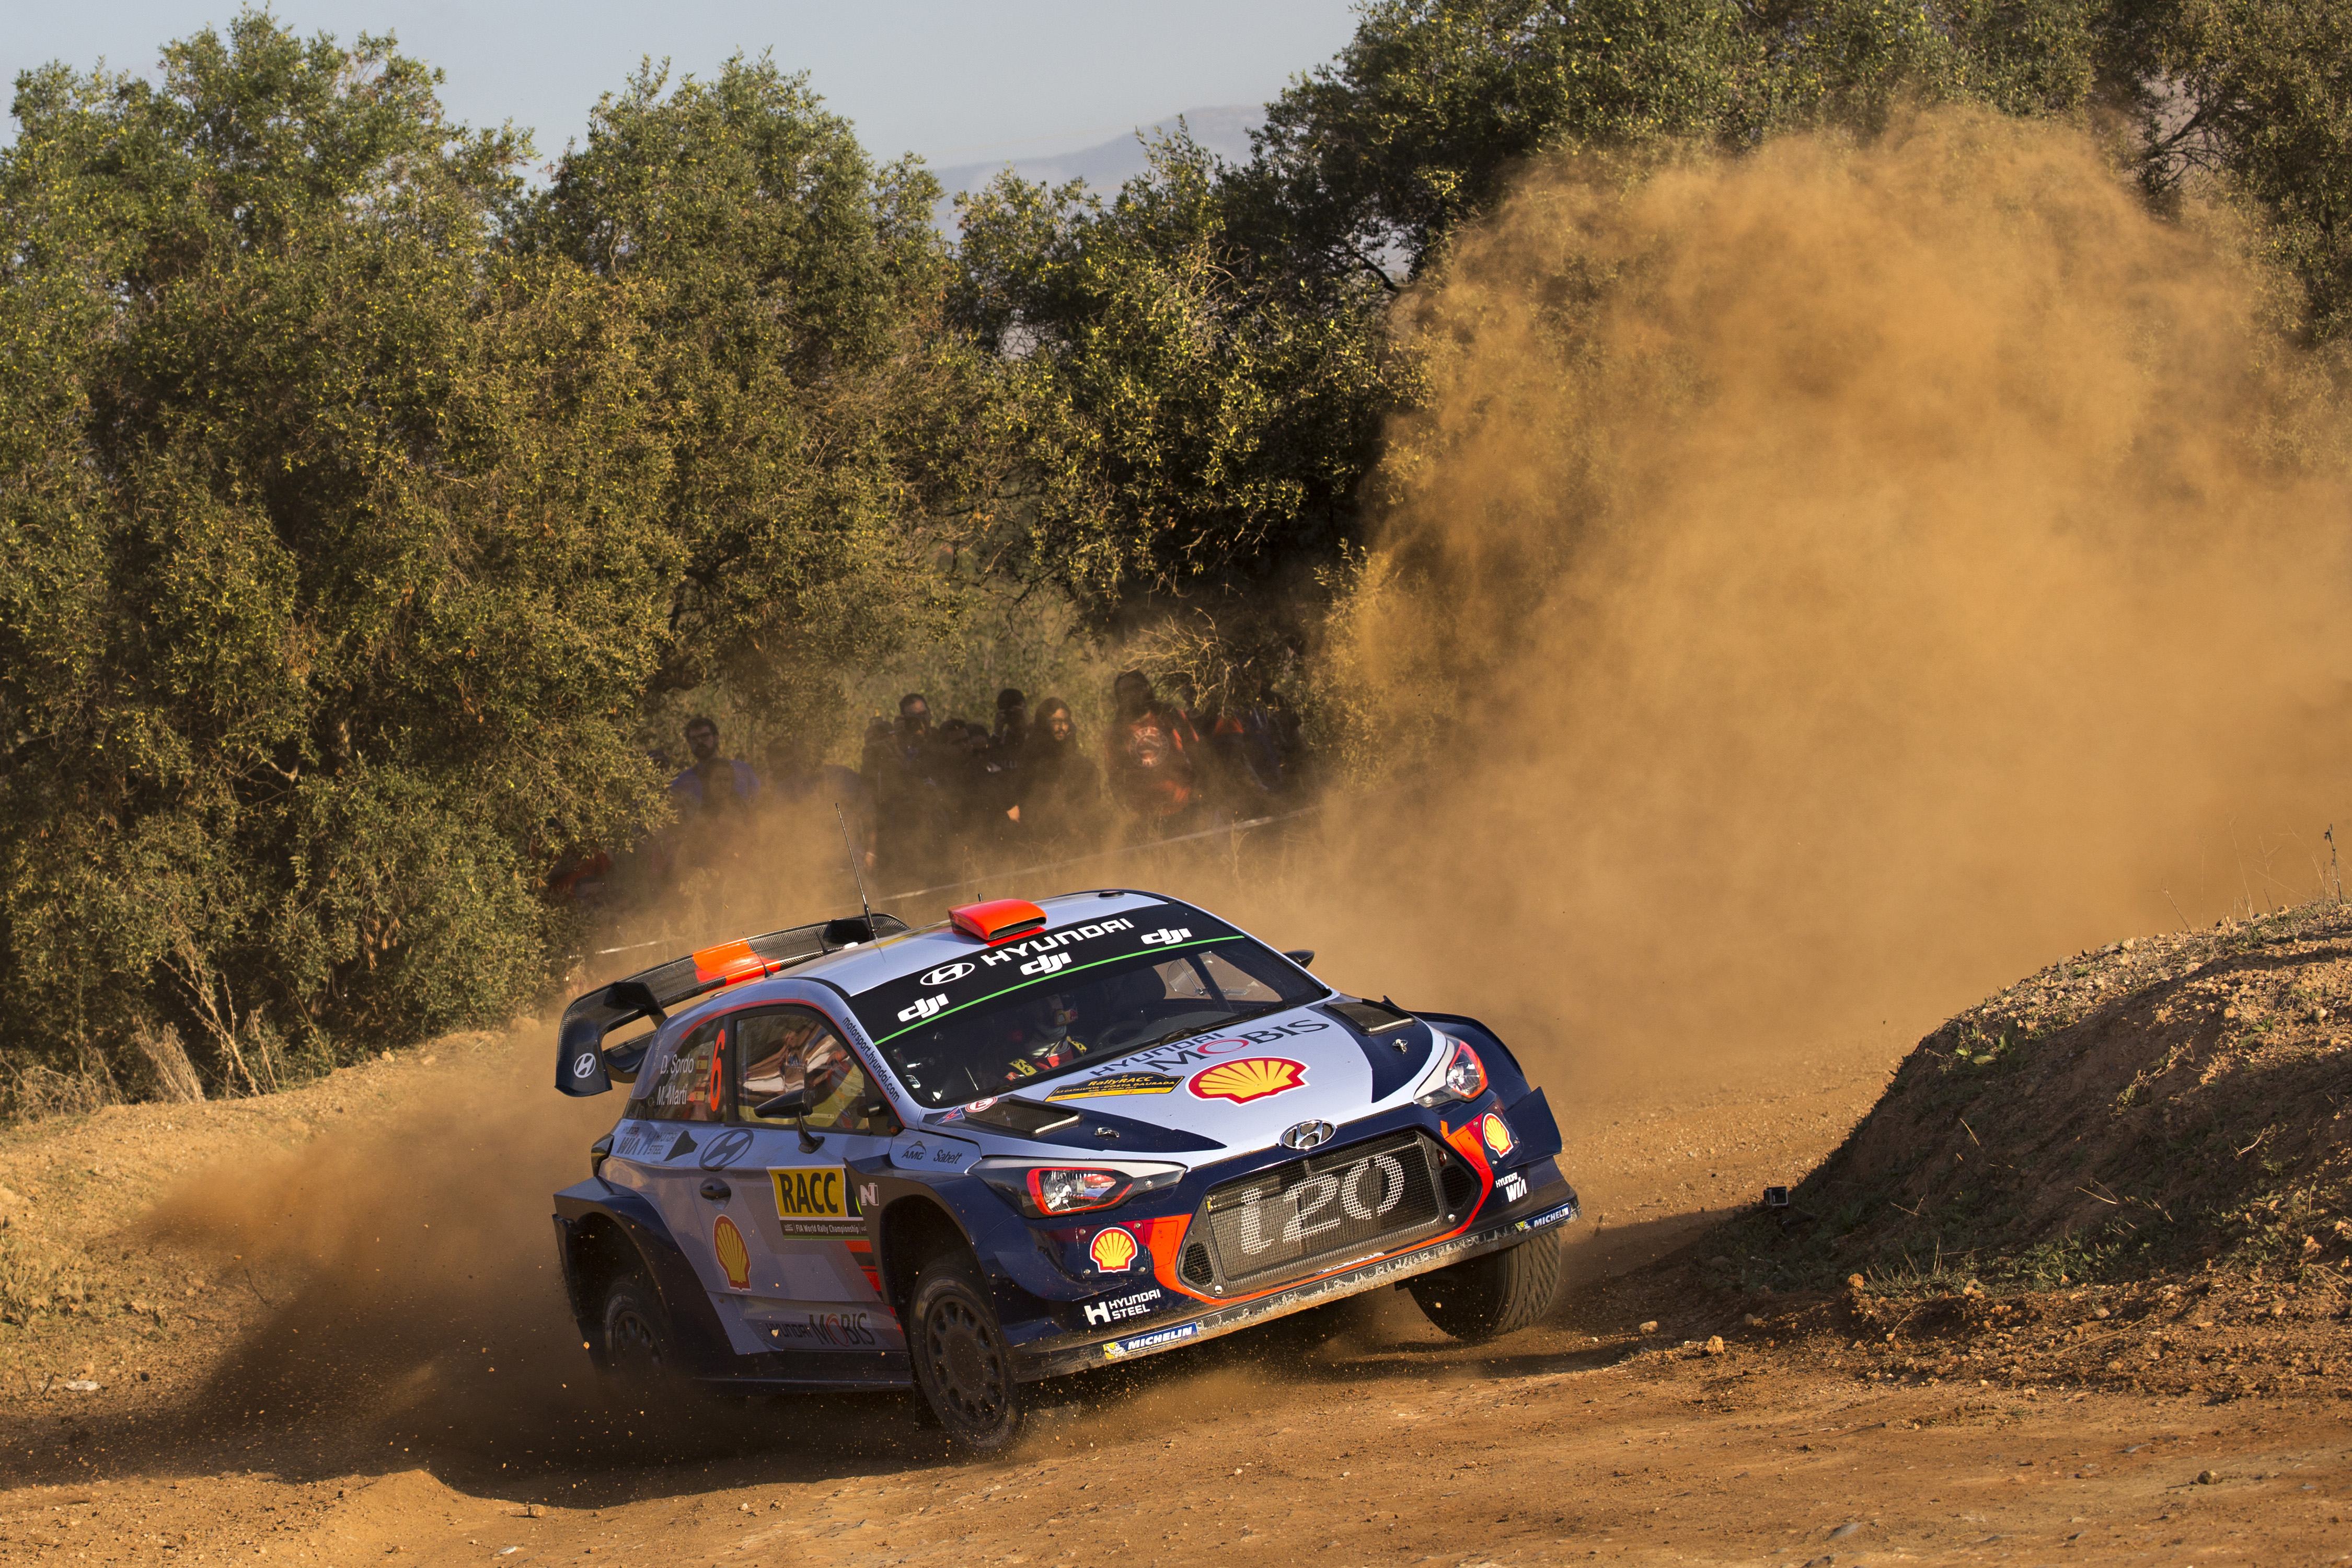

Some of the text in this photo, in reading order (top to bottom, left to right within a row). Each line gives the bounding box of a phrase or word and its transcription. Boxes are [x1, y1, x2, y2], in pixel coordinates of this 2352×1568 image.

[981, 918, 1134, 966] HYUNDAI
[1141, 928, 1192, 944] dji
[1020, 952, 1072, 975] dji
[897, 993, 949, 1022] dji
[1090, 1033, 1225, 1076] HYUNDAI
[1143, 1019, 1330, 1073] MOBIS
[660, 1054, 694, 1075] D. Sordo
[710, 1029, 725, 1112] 6
[843, 1017, 900, 1102] motorsport.hyundai.com
[1088, 1076, 1154, 1087] RallyRACC
[656, 1086, 665, 1105] M.
[933, 1149, 963, 1164] Sabelt
[1495, 1172, 1518, 1188] HYUNDAI
[778, 1172, 838, 1214] RACC
[1534, 1207, 1569, 1228] MICHELIN
[817, 1225, 828, 1233] Rally
[829, 1225, 859, 1234] Championship
[1109, 1289, 1161, 1310] HYUNDAI
[1112, 1304, 1150, 1320] STEEL
[809, 1313, 875, 1347] MOBIS
[1127, 1327, 1193, 1351] MICHELIN
